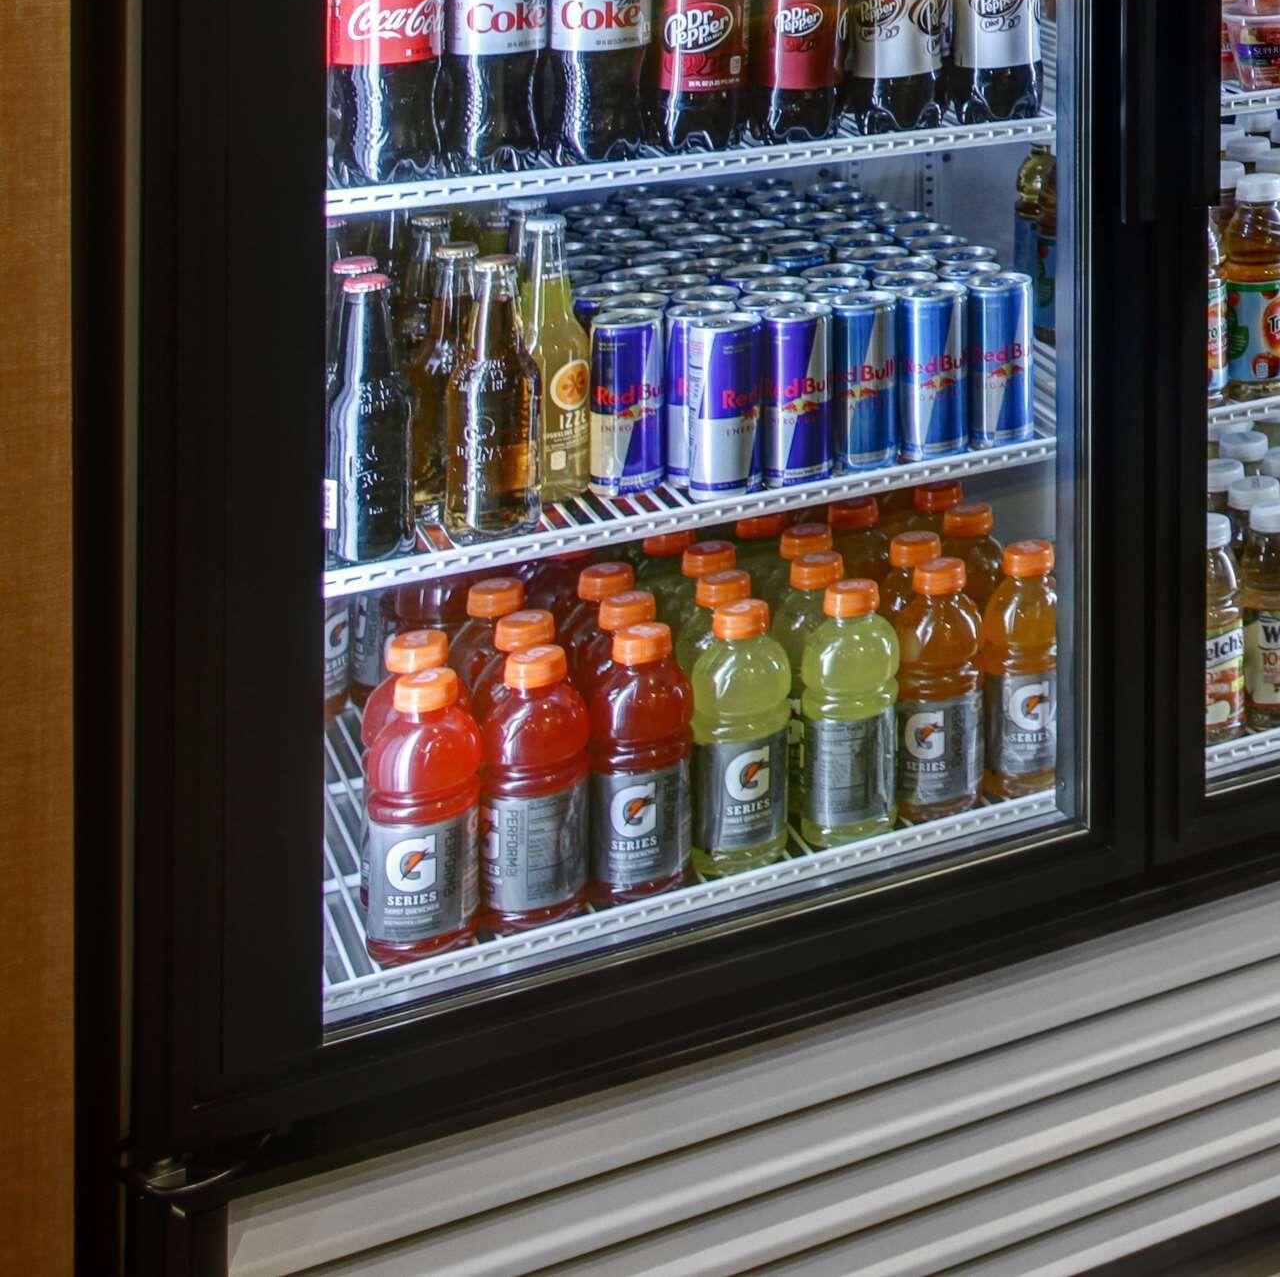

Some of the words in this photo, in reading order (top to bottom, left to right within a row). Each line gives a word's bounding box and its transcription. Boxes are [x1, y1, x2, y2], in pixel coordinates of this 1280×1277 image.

[466, 2, 547, 34] Coke
[561, 0, 641, 31] Coke
[687, 9, 714, 28] Dr
[779, 10, 820, 34] Pepper
[790, 7, 810, 20] Dr
[861, 1, 896, 23] Pepper
[670, 14, 729, 49] Pepper
[861, 358, 896, 382] Bull
[595, 384, 636, 407] Red
[560, 409, 587, 430] IZZE
[1206, 632, 1243, 661] elch's
[1009, 681, 1050, 732] G
[905, 711, 945, 760] G
[725, 746, 770, 801] G
[906, 760, 946, 772] SERIES
[610, 782, 657, 839] G
[726, 797, 771, 817] SERIES
[611, 836, 657, 851] SERIES
[385, 834, 437, 893] G
[387, 892, 438, 906] SERIES
